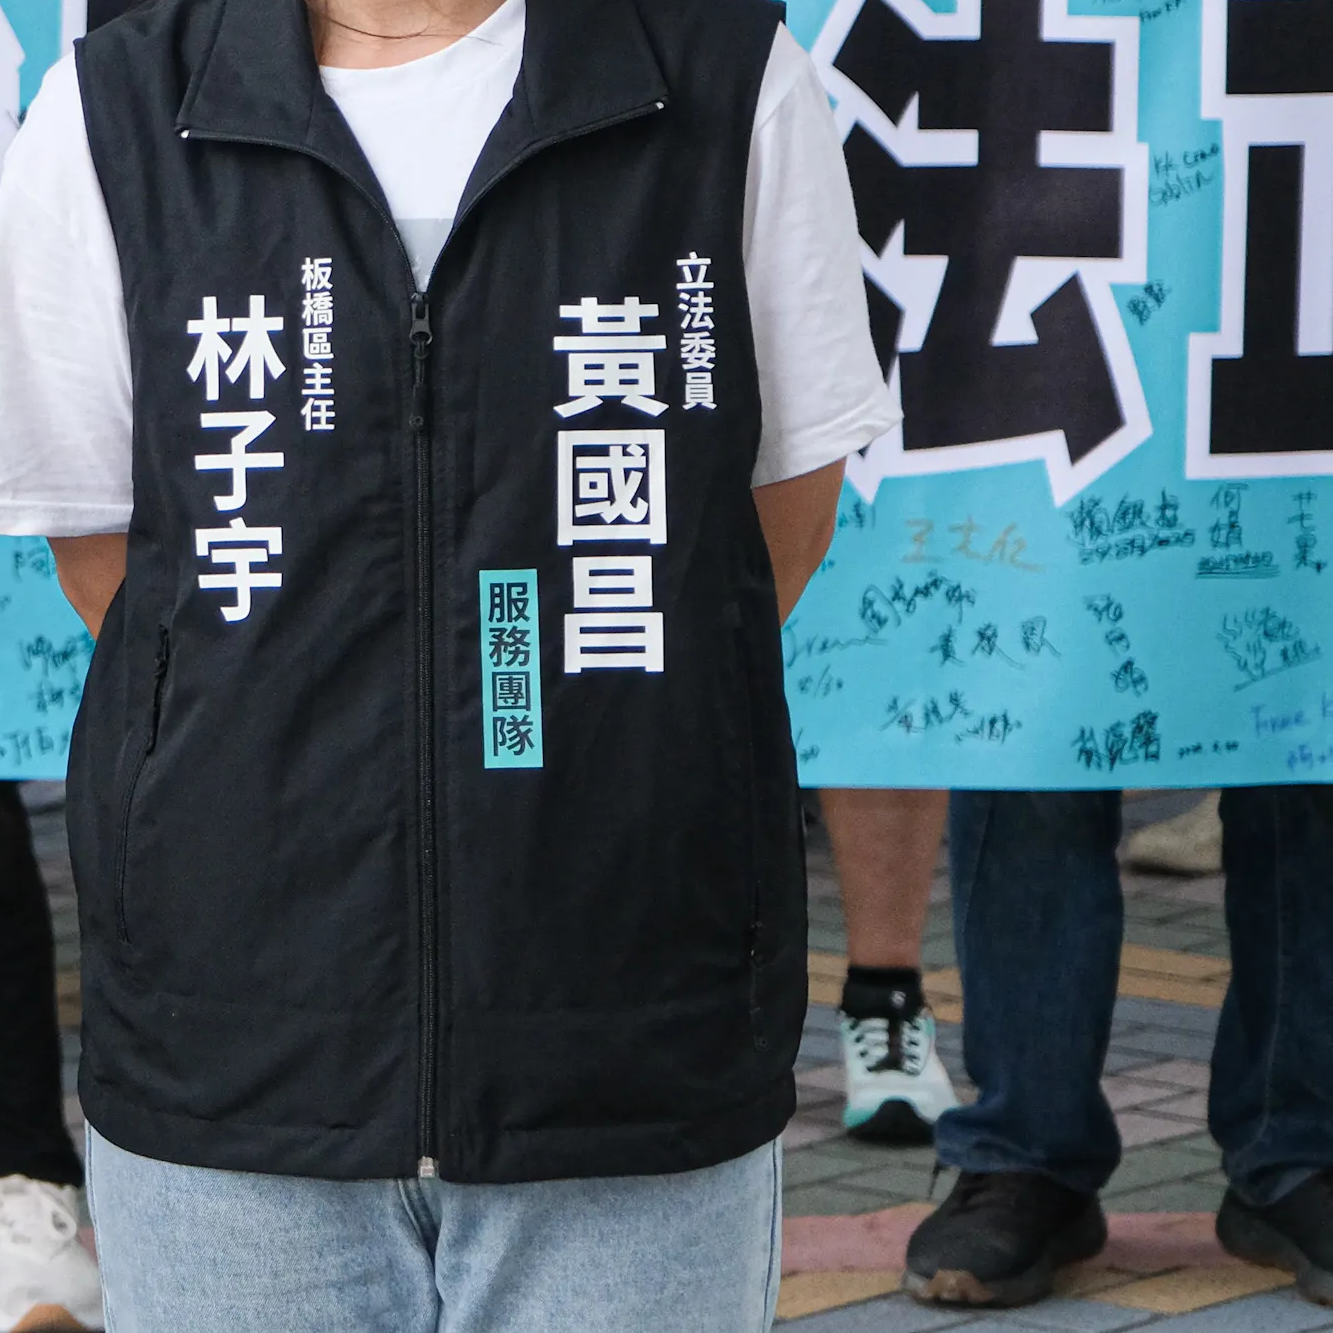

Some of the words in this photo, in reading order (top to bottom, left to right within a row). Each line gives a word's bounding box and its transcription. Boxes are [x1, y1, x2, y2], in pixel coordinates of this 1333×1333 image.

[299, 255, 336, 431] 板橋區主任
[676, 251, 717, 411] 立法委員
[186, 295, 285, 624] 林子宇
[552, 296, 668, 674] 黃國昌
[487, 580, 535, 758] 服務團隊
